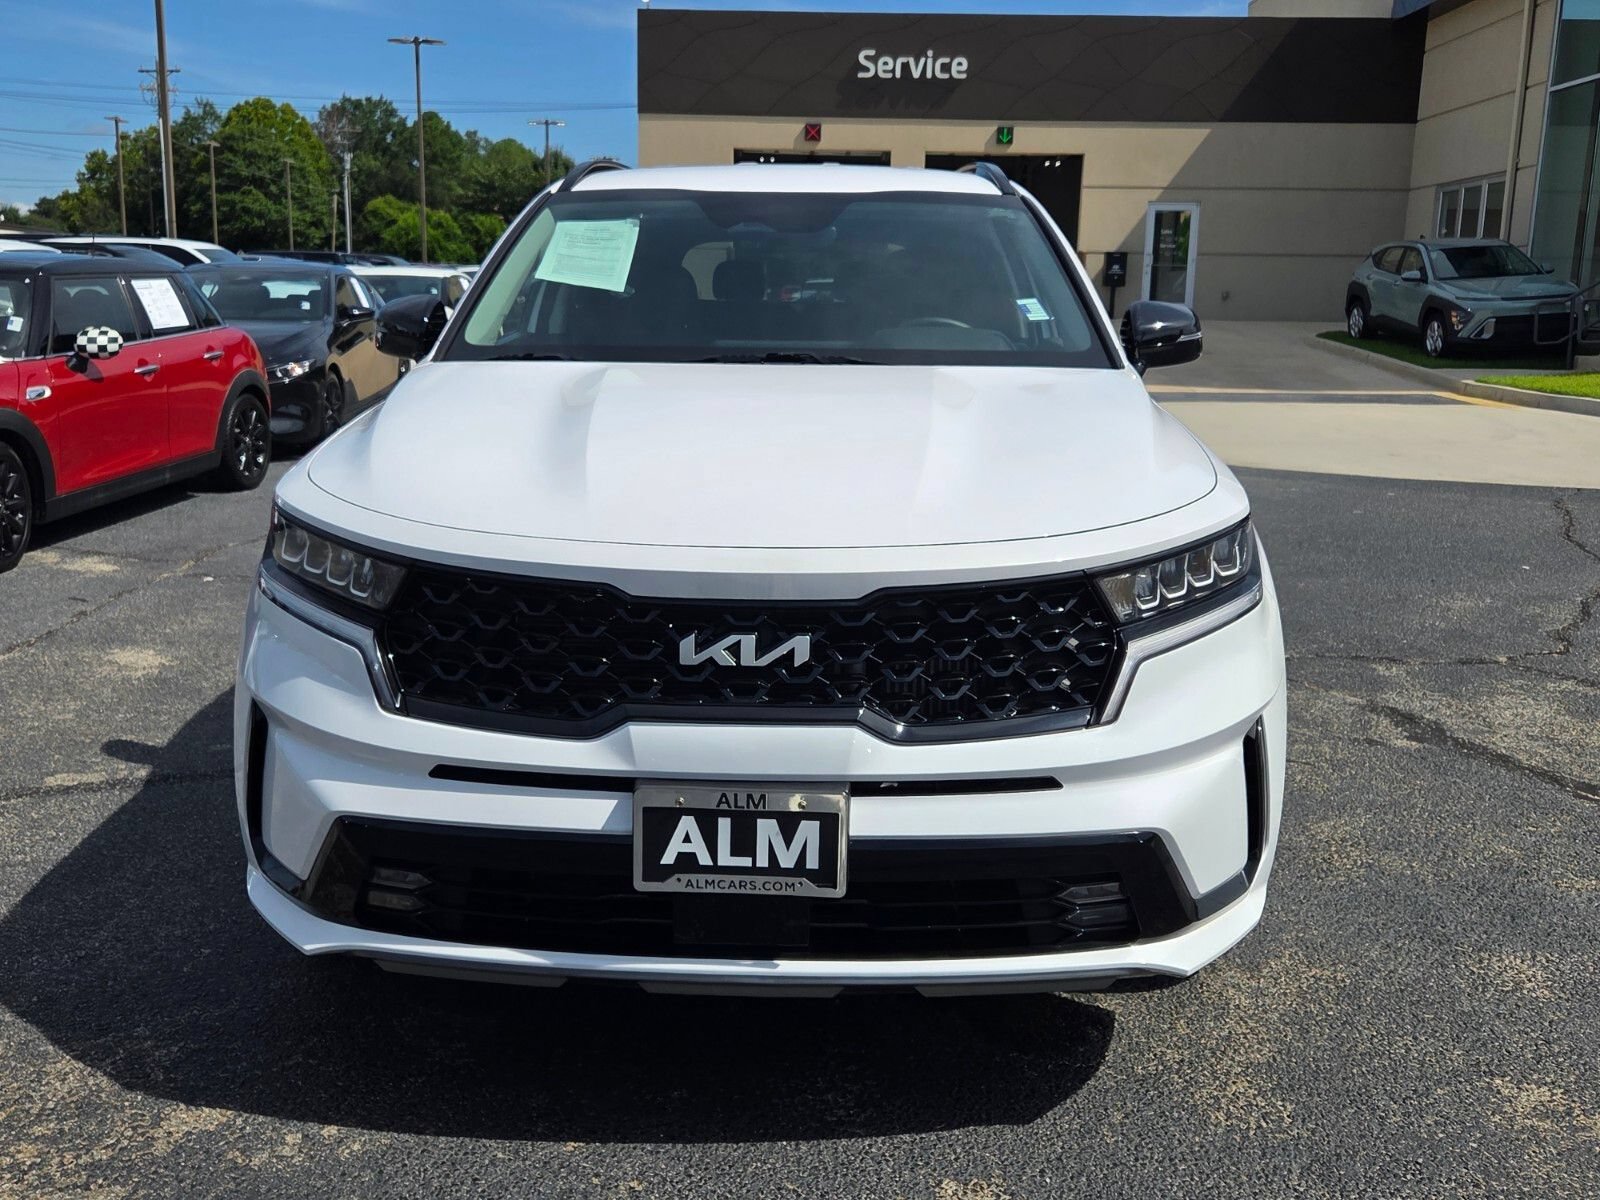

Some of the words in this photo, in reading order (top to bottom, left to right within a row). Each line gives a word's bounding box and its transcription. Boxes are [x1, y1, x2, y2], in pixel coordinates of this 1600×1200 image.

[857, 49, 969, 79] Service
[679, 632, 811, 667] KIA
[715, 792, 767, 810] ALM
[659, 815, 821, 870] ALM
[684, 878, 797, 892] ALMCARS.COM
